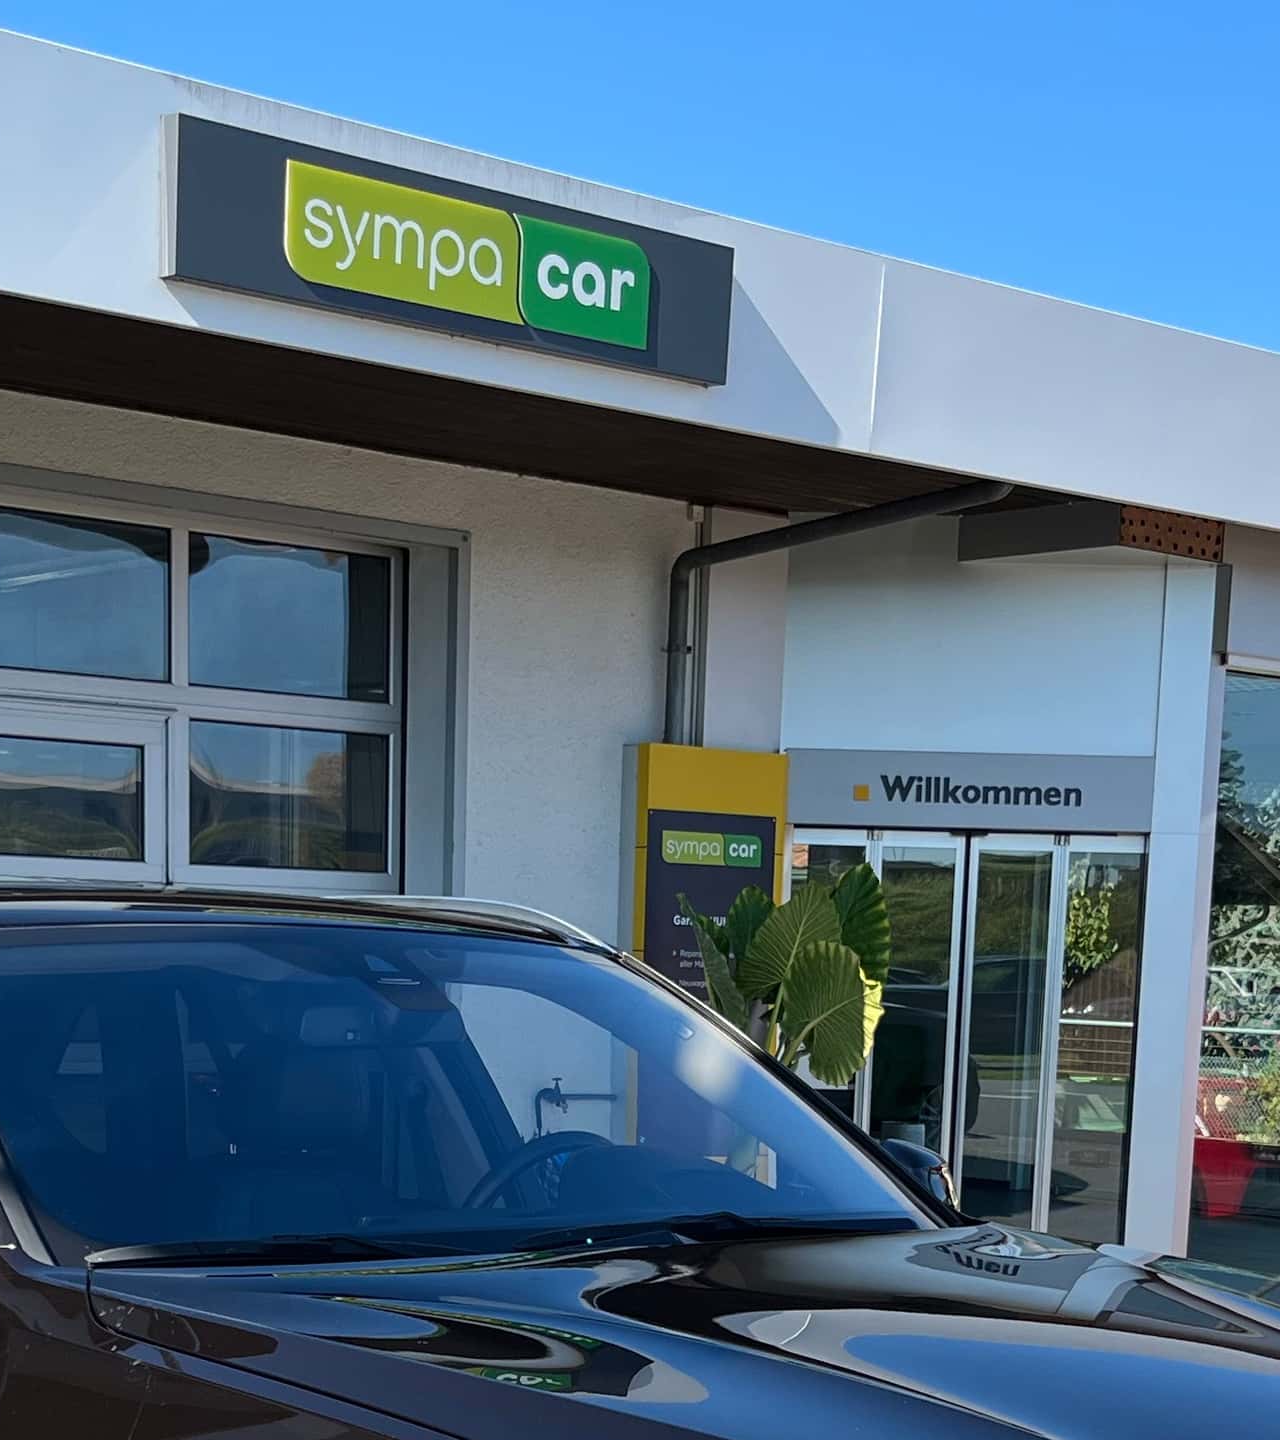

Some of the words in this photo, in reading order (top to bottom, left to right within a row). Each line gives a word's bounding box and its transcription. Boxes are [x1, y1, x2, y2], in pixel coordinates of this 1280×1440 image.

[303, 197, 503, 290] sympa
[536, 253, 635, 312] car
[879, 774, 1083, 807] Willkommen
[665, 839, 721, 861] sympa
[729, 843, 758, 859] car
